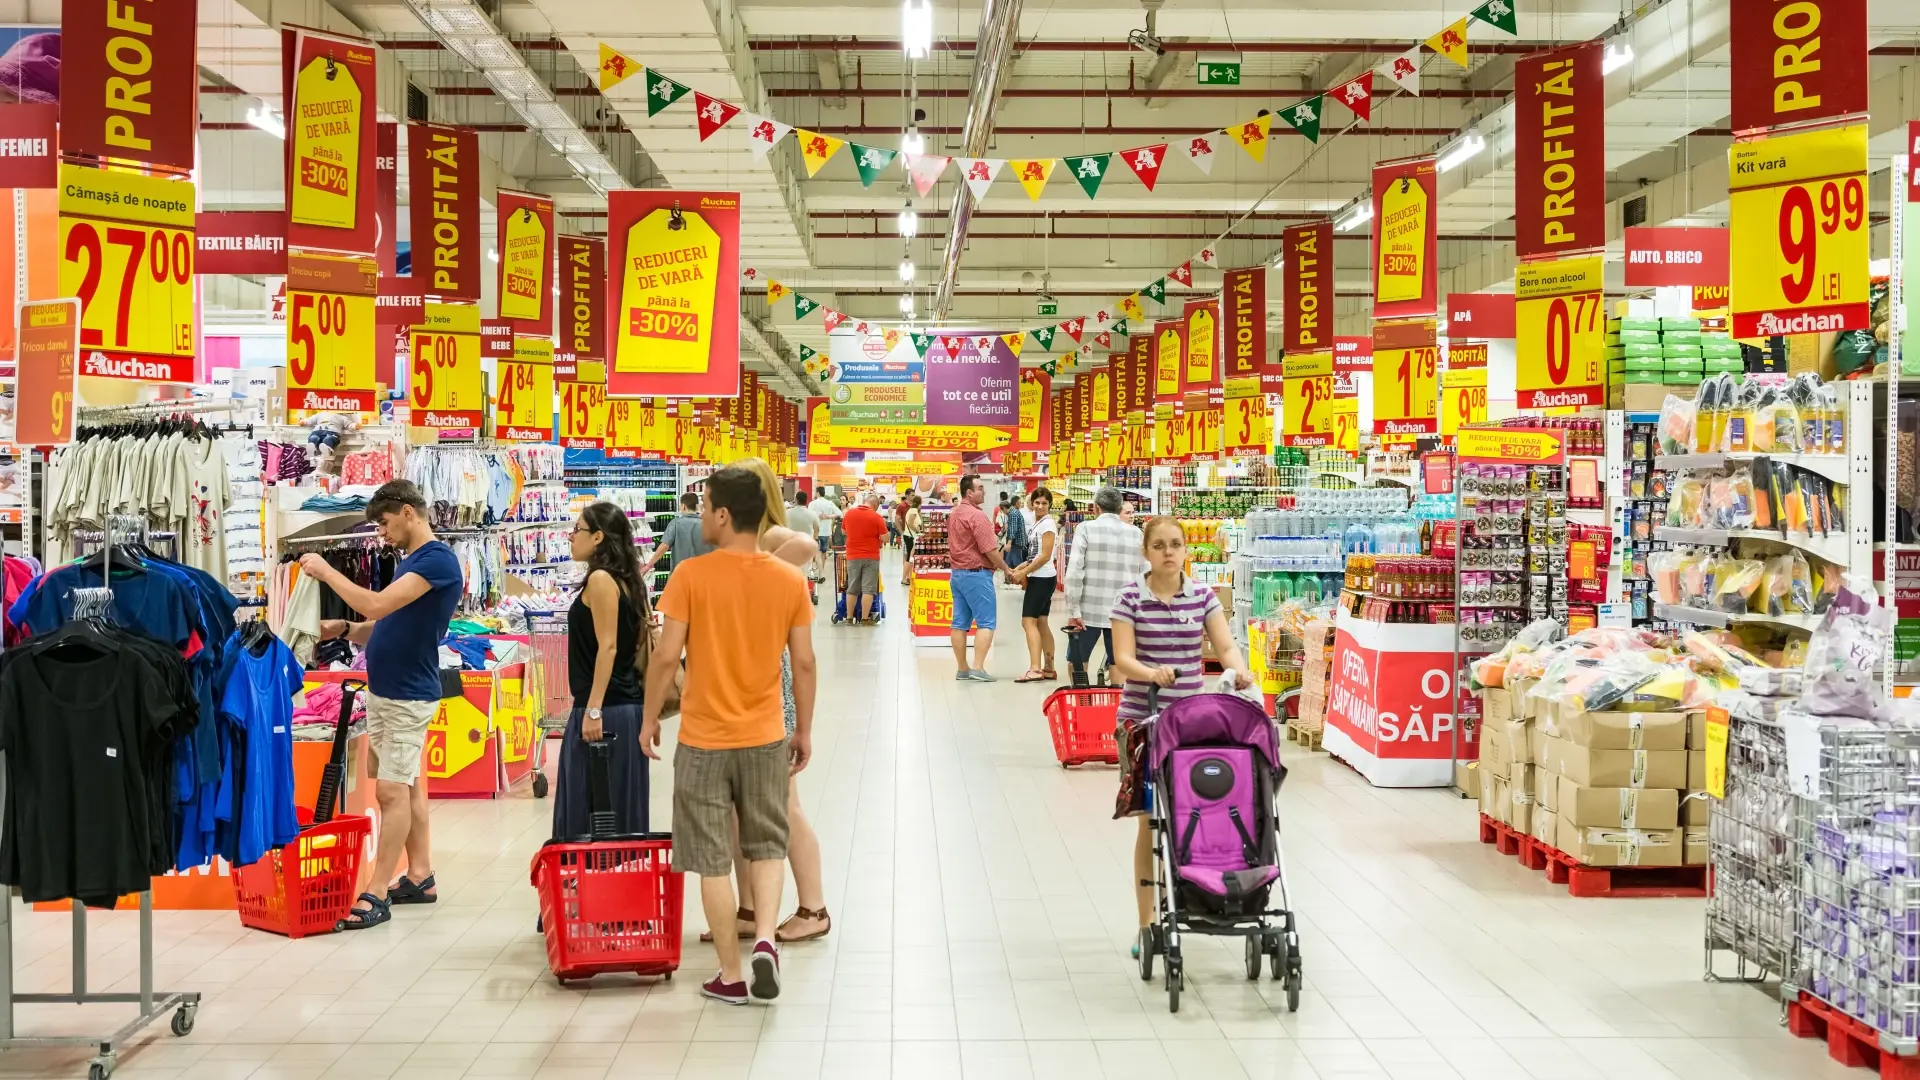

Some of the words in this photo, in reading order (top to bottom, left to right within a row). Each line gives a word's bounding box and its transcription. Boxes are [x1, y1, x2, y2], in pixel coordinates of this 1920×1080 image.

[302, 100, 354, 119] REDUCERI
[305, 125, 321, 140] DE
[321, 116, 352, 138] VARĂ
[0, 139, 48, 157] FEMEI
[312, 145, 332, 159] până
[334, 151, 344, 161] la
[1535, 58, 1576, 245] PROFITĂ!
[1737, 150, 1758, 159] Bottari
[1737, 161, 1755, 174] Kit
[1758, 156, 1787, 171] vară
[302, 161, 348, 191] -30%
[124, 193, 139, 205] de
[143, 194, 187, 212] noapte
[701, 197, 737, 206] Auchan
[426, 133, 459, 291] PROFITĂ!
[1384, 203, 1422, 227] REDUCERI
[1387, 228, 1397, 241] DE
[1397, 218, 1420, 237] VARĂ
[197, 237, 243, 251] TEXTILE
[509, 234, 541, 249] REDUCERI
[1779, 186, 1817, 304] 9
[511, 252, 522, 262] DE
[521, 248, 539, 261] VARĂ
[632, 245, 709, 270] REDUCERI
[1629, 250, 1663, 265] AUTO,
[1665, 250, 1703, 264] BRICO
[290, 266, 311, 278] Tricou
[1384, 256, 1417, 273] -30%
[637, 276, 659, 290] DE
[660, 264, 705, 286] VARĂ
[1519, 277, 1540, 288] Bere
[1541, 275, 1558, 286] non
[1559, 271, 1587, 284] alcool
[508, 275, 536, 297] -30%
[1295, 229, 1318, 345] PROFITĂ!
[1822, 273, 1841, 301] LEI
[401, 296, 421, 306] FETE
[570, 243, 591, 352] PROFITĂ!
[647, 295, 678, 307] până
[679, 298, 691, 309] la
[31, 303, 67, 316] REDUCERI
[1454, 310, 1472, 322] APĂ
[434, 315, 451, 324] bebe
[631, 311, 698, 337] -30%
[1233, 272, 1253, 371] PROFITĂ!
[1757, 312, 1845, 336] Auchan
[175, 323, 192, 351] LEI
[290, 294, 315, 386] 5
[491, 341, 511, 350] BEBE
[1546, 298, 1571, 385] 0
[22, 342, 46, 353] Tricou
[47, 339, 68, 351] damă
[1336, 342, 1358, 352] SIROP
[85, 352, 171, 381] Auchan
[844, 364, 880, 372] Produsele
[931, 356, 944, 364] ce
[961, 355, 1001, 364] nevoie.
[1286, 363, 1296, 371] Suc
[1336, 355, 1351, 365] SUC
[334, 365, 347, 387] LEI
[413, 335, 433, 408] 5
[1135, 338, 1149, 406] PROFITĂ!
[1585, 361, 1598, 381] LEI
[864, 386, 907, 394] PRODUSELE
[980, 376, 1012, 388] Oferim
[1114, 356, 1127, 418] PROFITĂ!
[1397, 350, 1411, 418] 1
[303, 391, 361, 412] Auchan
[447, 392, 458, 409] LEI
[498, 364, 514, 425] 4
[864, 394, 907, 402] ECONOMICE
[943, 389, 961, 401] tot
[964, 391, 978, 401] ce
[981, 391, 988, 401] e
[991, 388, 1012, 401] util
[1081, 375, 1089, 428] PROFITĂ!
[1532, 391, 1588, 408] Auchan
[51, 391, 64, 437] 9
[564, 383, 589, 435] 15
[849, 410, 879, 419] Auchan
[969, 403, 1012, 415] fiecăruia.
[1300, 379, 1315, 433] 2
[1426, 399, 1436, 416] LEI
[424, 412, 470, 428] Auchan
[606, 401, 617, 447] 4
[1239, 399, 1250, 444] 3
[1384, 420, 1426, 434] Auchan
[507, 427, 542, 440] Auchan
[850, 426, 917, 436] REDUCERI
[1165, 420, 1175, 456] 3
[1469, 434, 1507, 443] REDUCERI
[566, 438, 596, 448] Auchan
[908, 437, 977, 449] -30%
[1292, 436, 1326, 446] Auchan
[1509, 436, 1519, 444] DE
[611, 449, 636, 458] Auchan
[1190, 453, 1214, 461] Auchan
[1232, 448, 1260, 457] Auchan
[1501, 445, 1541, 457] -30%
[936, 589, 949, 600] DE
[917, 606, 926, 616] la
[462, 673, 493, 684] Auchan
[1421, 669, 1452, 700] O
[1378, 704, 1454, 742] SĂP
